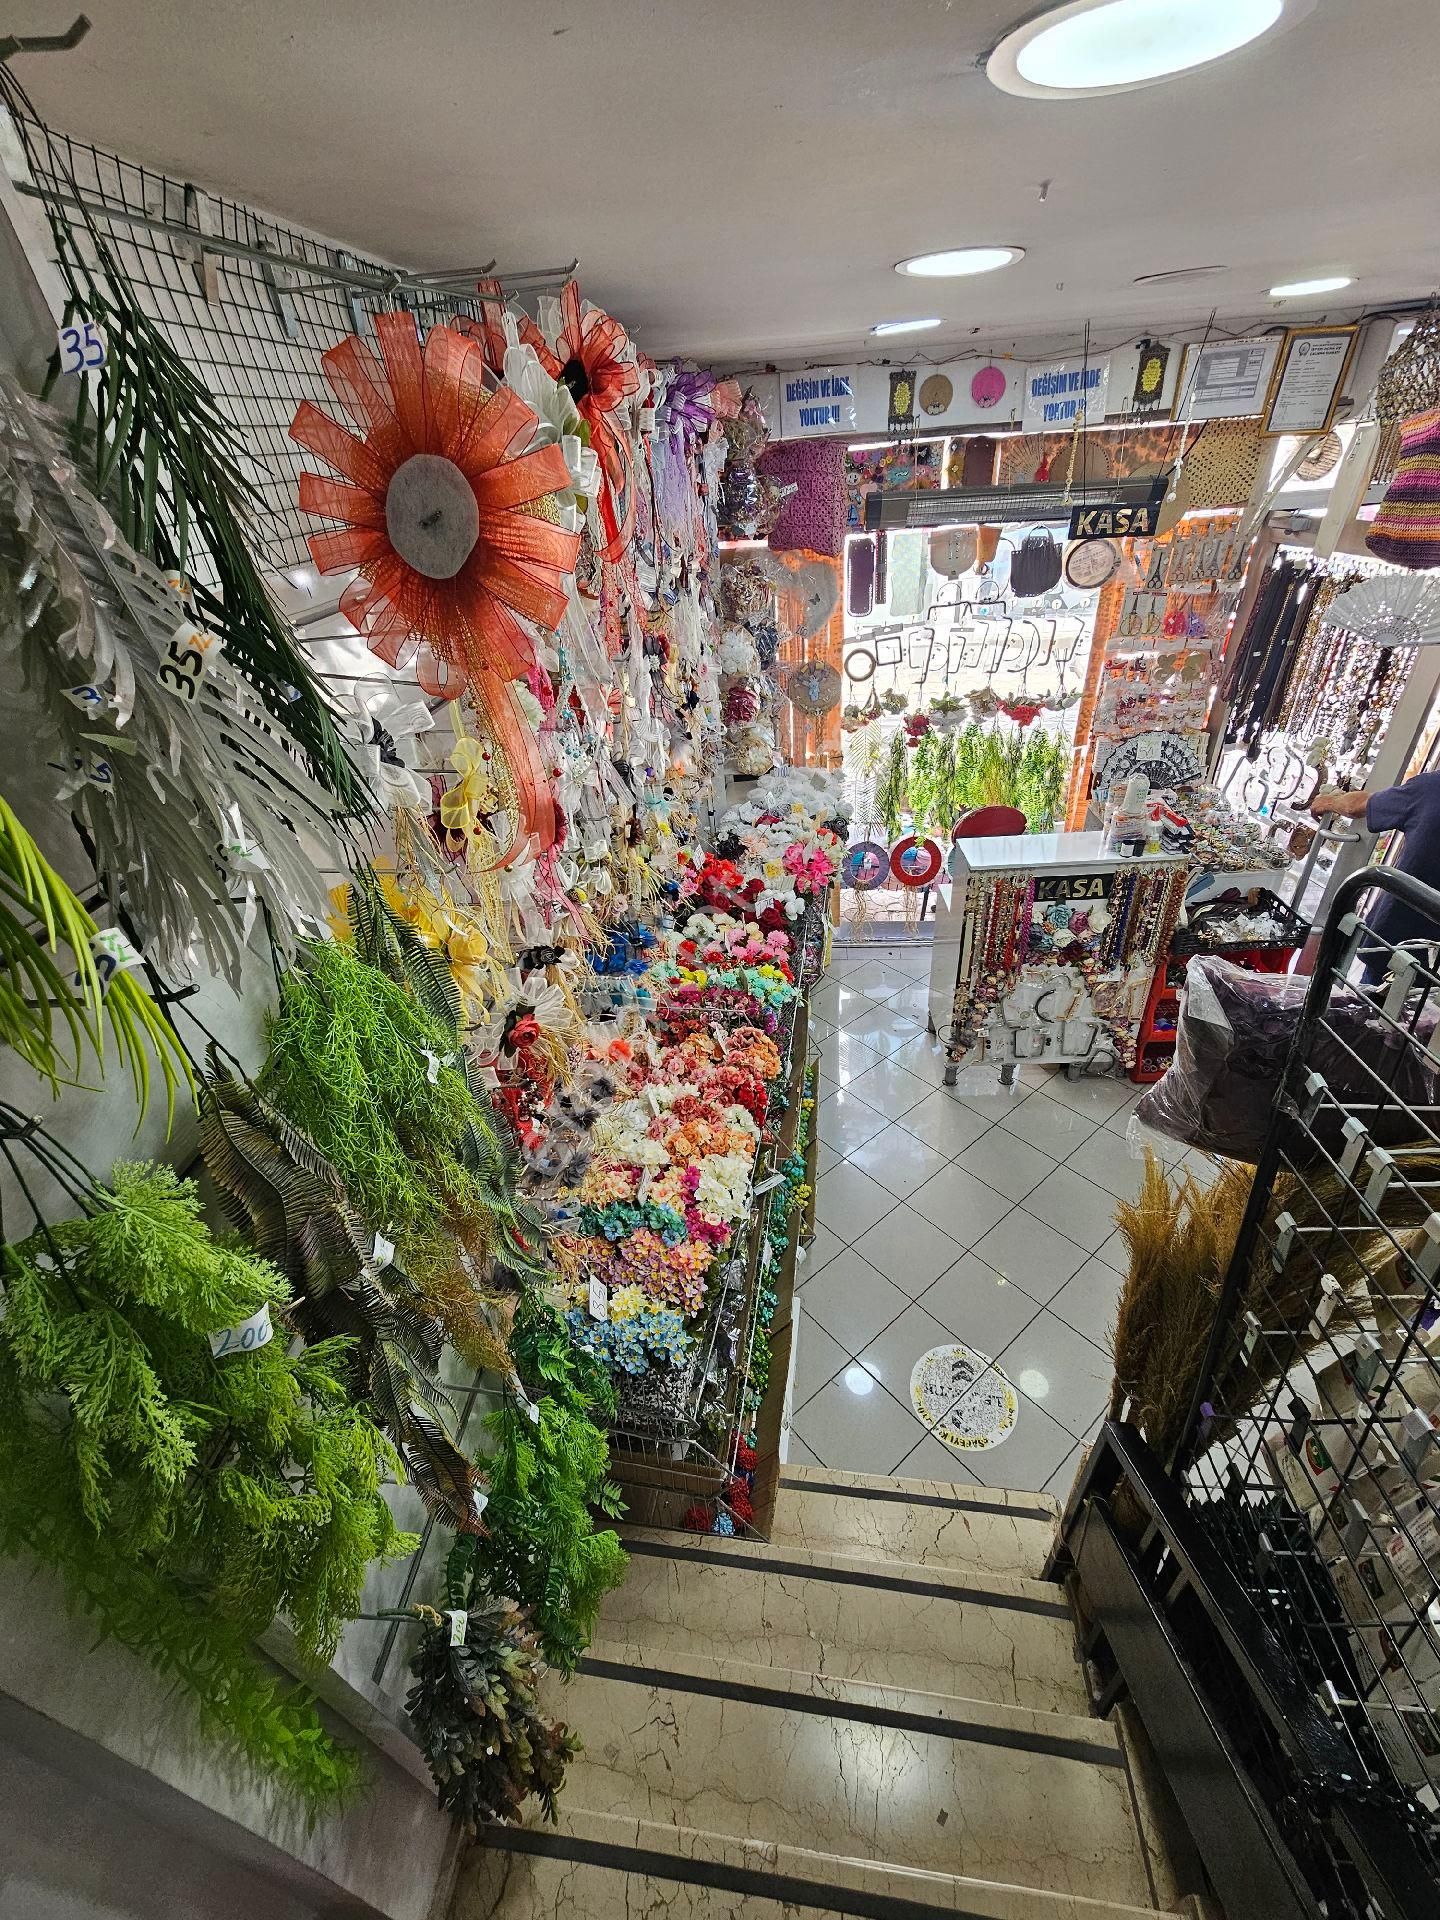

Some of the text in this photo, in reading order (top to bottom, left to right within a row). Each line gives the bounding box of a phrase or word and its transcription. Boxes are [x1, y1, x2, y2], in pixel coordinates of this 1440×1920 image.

[62, 323, 104, 375] 35
[786, 375, 851, 403] DEĞİŞİM VE İADE
[1031, 372, 1068, 398] DEĞİŞİM
[1069, 371, 1080, 392] VE
[799, 406, 830, 427] YOKTUR
[1043, 400, 1077, 422] YOKTUR
[1076, 507, 1150, 536] KASA
[159, 640, 203, 700] 35
[1037, 878, 1104, 900] KASA
[213, 1319, 269, 1358] 200
